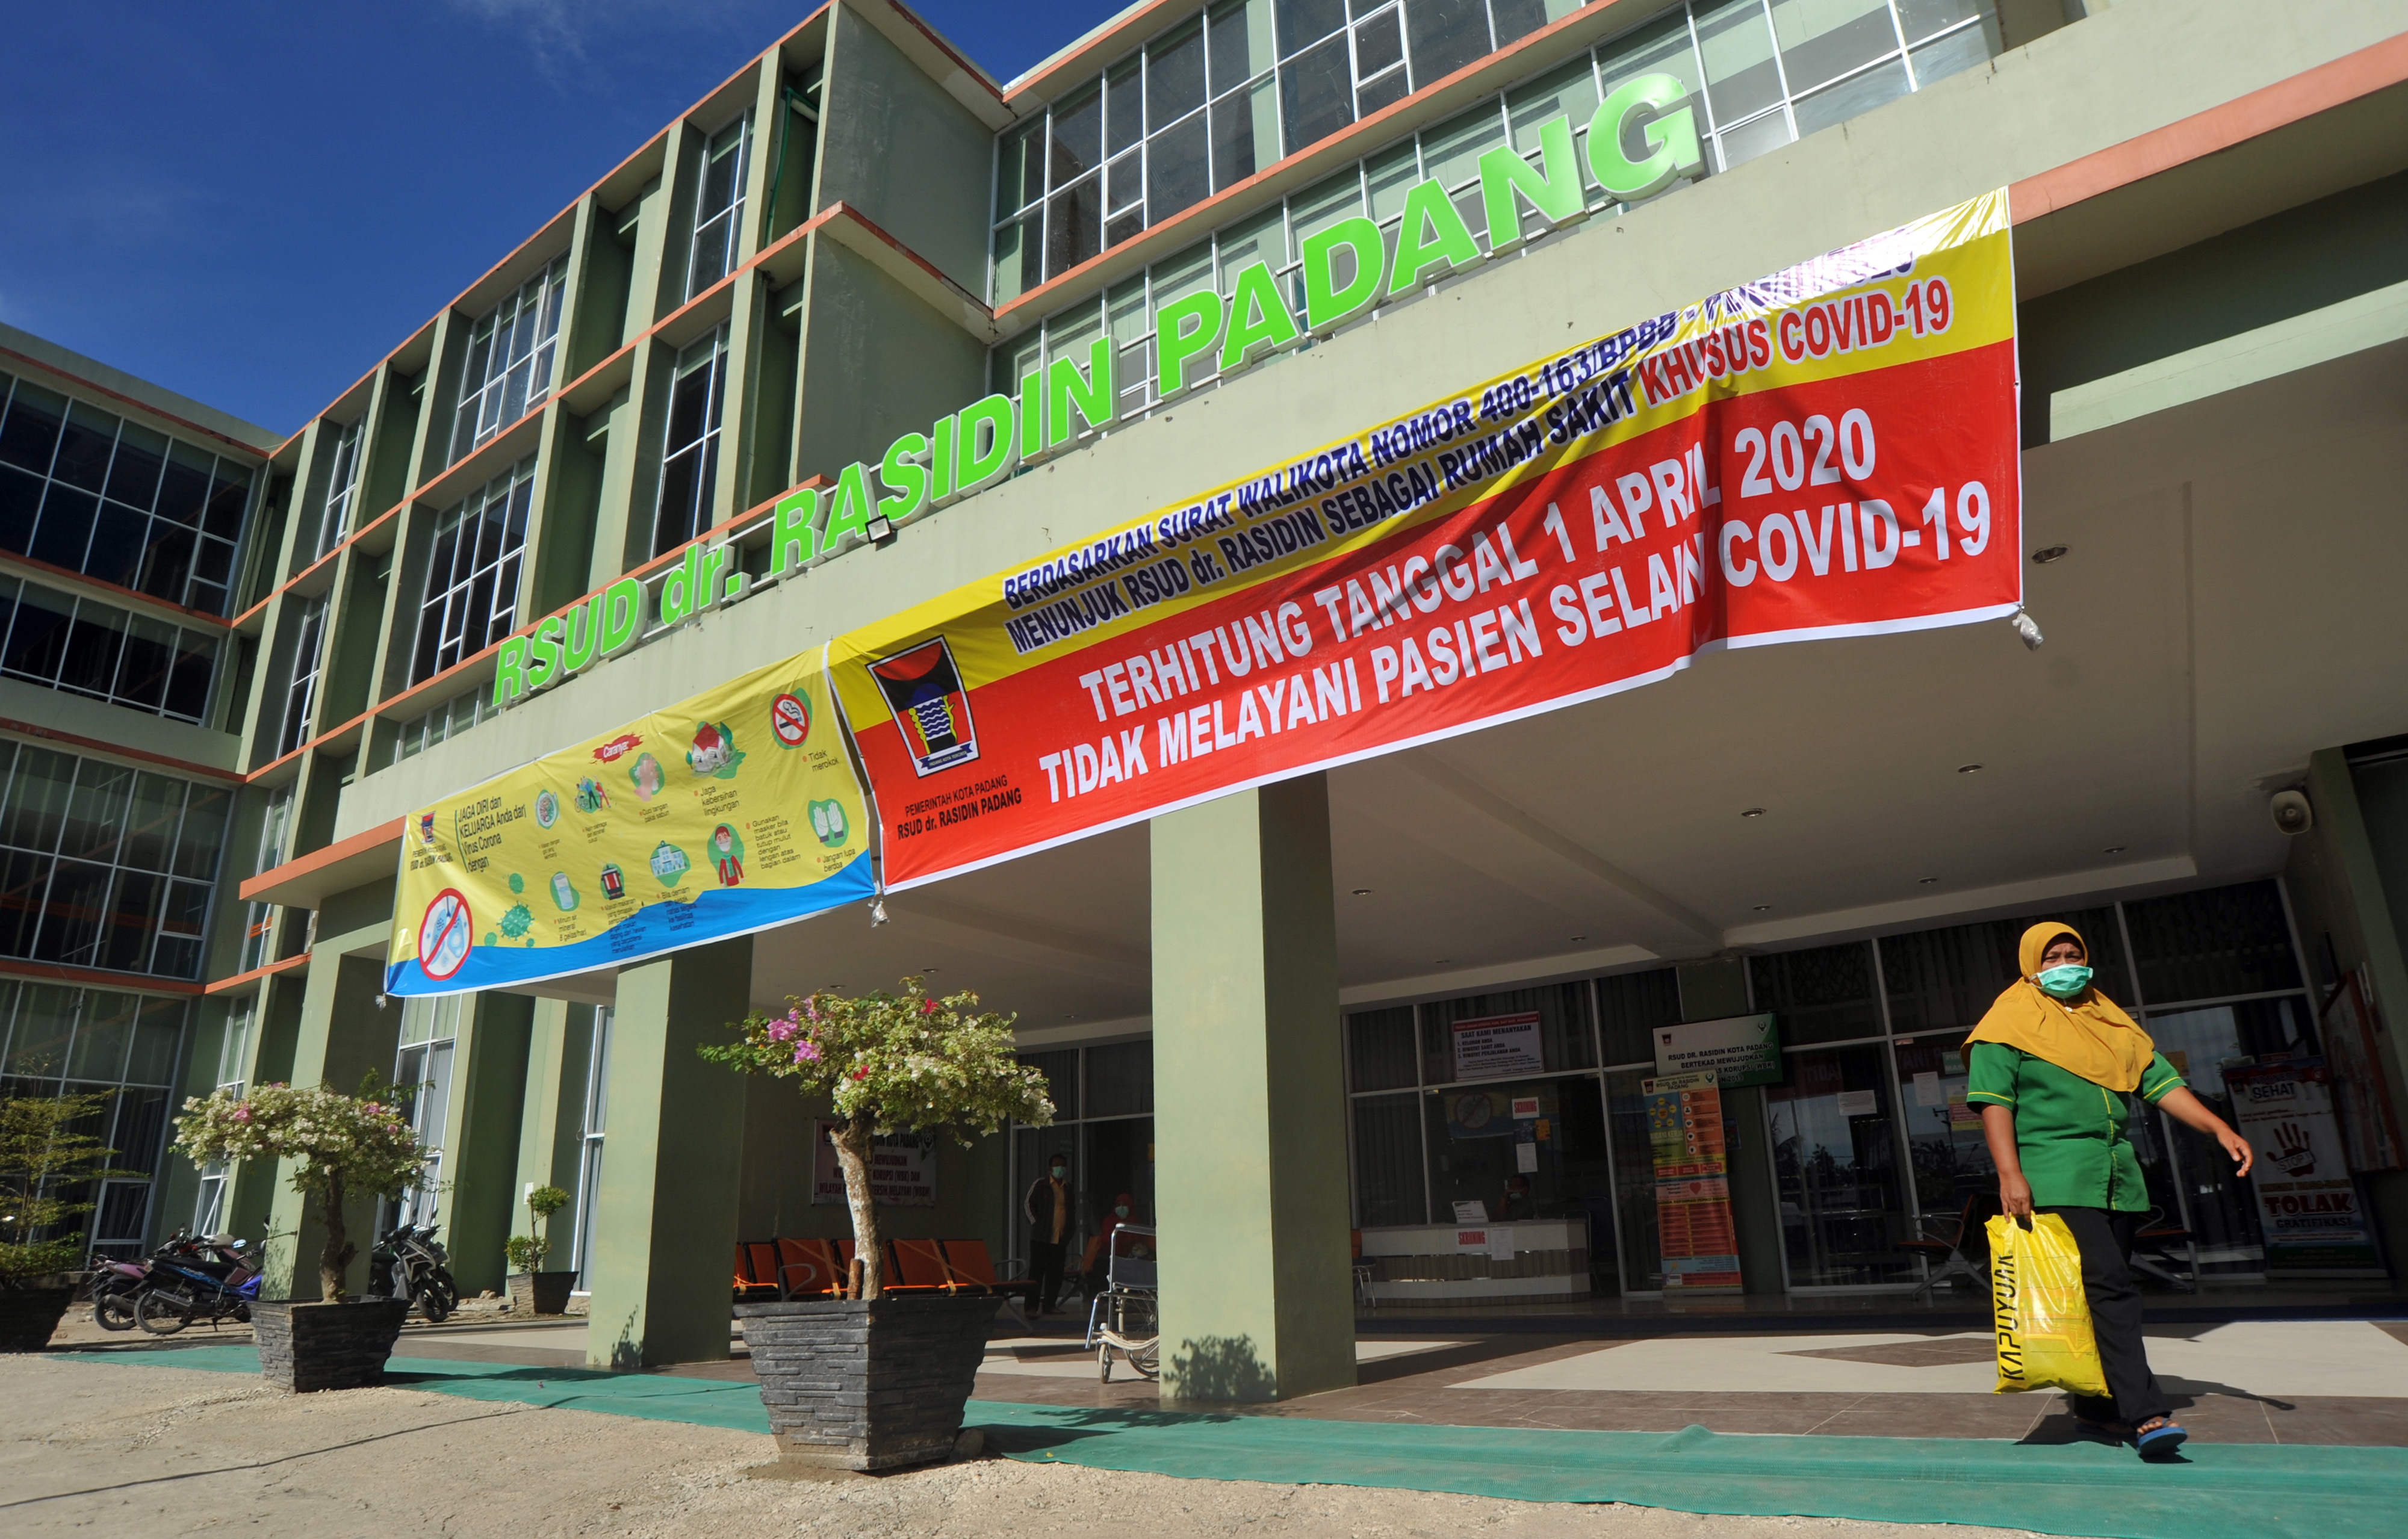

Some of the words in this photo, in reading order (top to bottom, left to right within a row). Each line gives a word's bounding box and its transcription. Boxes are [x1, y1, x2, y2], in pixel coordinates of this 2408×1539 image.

[492, 577, 647, 708] RSUD
[661, 542, 749, 627] dr.
[771, 334, 1117, 578] RASIDIN
[1156, 73, 1702, 402] PADANG
[1005, 524, 1159, 610] BERDASARKAN
[1158, 492, 1233, 548] SURAT
[1238, 444, 1369, 519] WALIKOTA
[1370, 400, 1477, 470] NOMOR
[1480, 313, 1677, 422] 400-163/BPBD
[1005, 581, 1129, 653] MENUNJUK
[1122, 558, 1190, 608] RSUD
[1190, 549, 1224, 586] dr.
[1224, 509, 1326, 574] RASIDIN
[1322, 462, 1439, 534] SEBAGAI
[1438, 421, 1544, 491] RUMAH
[1550, 369, 1635, 445] SAKIT
[1637, 317, 1770, 406] KHUSUS
[1780, 279, 1950, 360] COVID-19
[1079, 601, 1313, 722] TERHITUNG
[1314, 522, 1538, 643] TANGGAL
[1543, 502, 1575, 563] 1
[1589, 441, 1721, 553] APRIL
[1734, 408, 1876, 498] 2020
[1038, 724, 1148, 804] TIDAK
[1157, 657, 1362, 768] MELAYANI
[1370, 598, 1542, 705] PASIEN
[1550, 531, 1705, 648] SELAIN
[1718, 480, 1991, 588] COVID-19
[808, 749, 828, 762] Tidak
[811, 757, 839, 772] merokok
[700, 785, 716, 796] Jaga
[701, 788, 737, 806] kebersihan
[905, 792, 952, 817] PEMERINTAH
[952, 785, 975, 805] KOTA
[975, 774, 1008, 795] PADANG
[458, 805, 476, 823] JAGA
[476, 799, 489, 816] DIRI
[490, 796, 501, 811] dan
[703, 799, 740, 816] lingkungan
[898, 818, 923, 840] RSUD
[925, 815, 937, 832] dr.
[939, 800, 979, 828] RASIDIN
[981, 787, 1022, 815] PADANG
[459, 814, 495, 839] KELUARGA
[497, 808, 513, 826] Anda
[752, 815, 780, 828] Gunakan
[777, 819, 789, 828] bila
[755, 831, 772, 841] batuk
[774, 828, 787, 836] atau
[757, 839, 772, 848] tutup
[774, 834, 791, 843] mulut
[462, 839, 479, 856] Virus
[478, 832, 502, 850] Corona
[758, 844, 781, 855] dengan
[759, 852, 780, 862] lengan
[781, 848, 794, 856] atas
[760, 859, 781, 869] bagian
[782, 854, 801, 863] dalam
[822, 852, 843, 864] Jangan
[843, 847, 855, 859] lupa
[467, 855, 489, 873] dengan
[824, 861, 843, 872] berdoa
[661, 891, 671, 899] Bila
[557, 915, 570, 924] Minum
[1477, 1029, 1491, 1037] KAMI
[1493, 1024, 1531, 1035] MENANYAKAN
[1699, 1048, 1726, 1057] RASIDIN
[1746, 1042, 1773, 1051] PADANG
[1681, 1060, 1715, 1069] BERTEKAD
[1717, 1053, 1764, 1065] MEWUJUDKAN
[1724, 1065, 1753, 1074] KORUPSI
[1755, 1062, 1775, 1072] (WBK)
[2253, 1083, 2295, 1099] SEHAT
[2277, 1155, 2303, 1171] STOP
[873, 1169, 894, 1180] KORUPSI
[819, 1183, 842, 1194] WILAYAH
[2264, 1193, 2353, 1215] TOLAK
[2276, 1217, 2352, 1228] GRATIFIKASI
